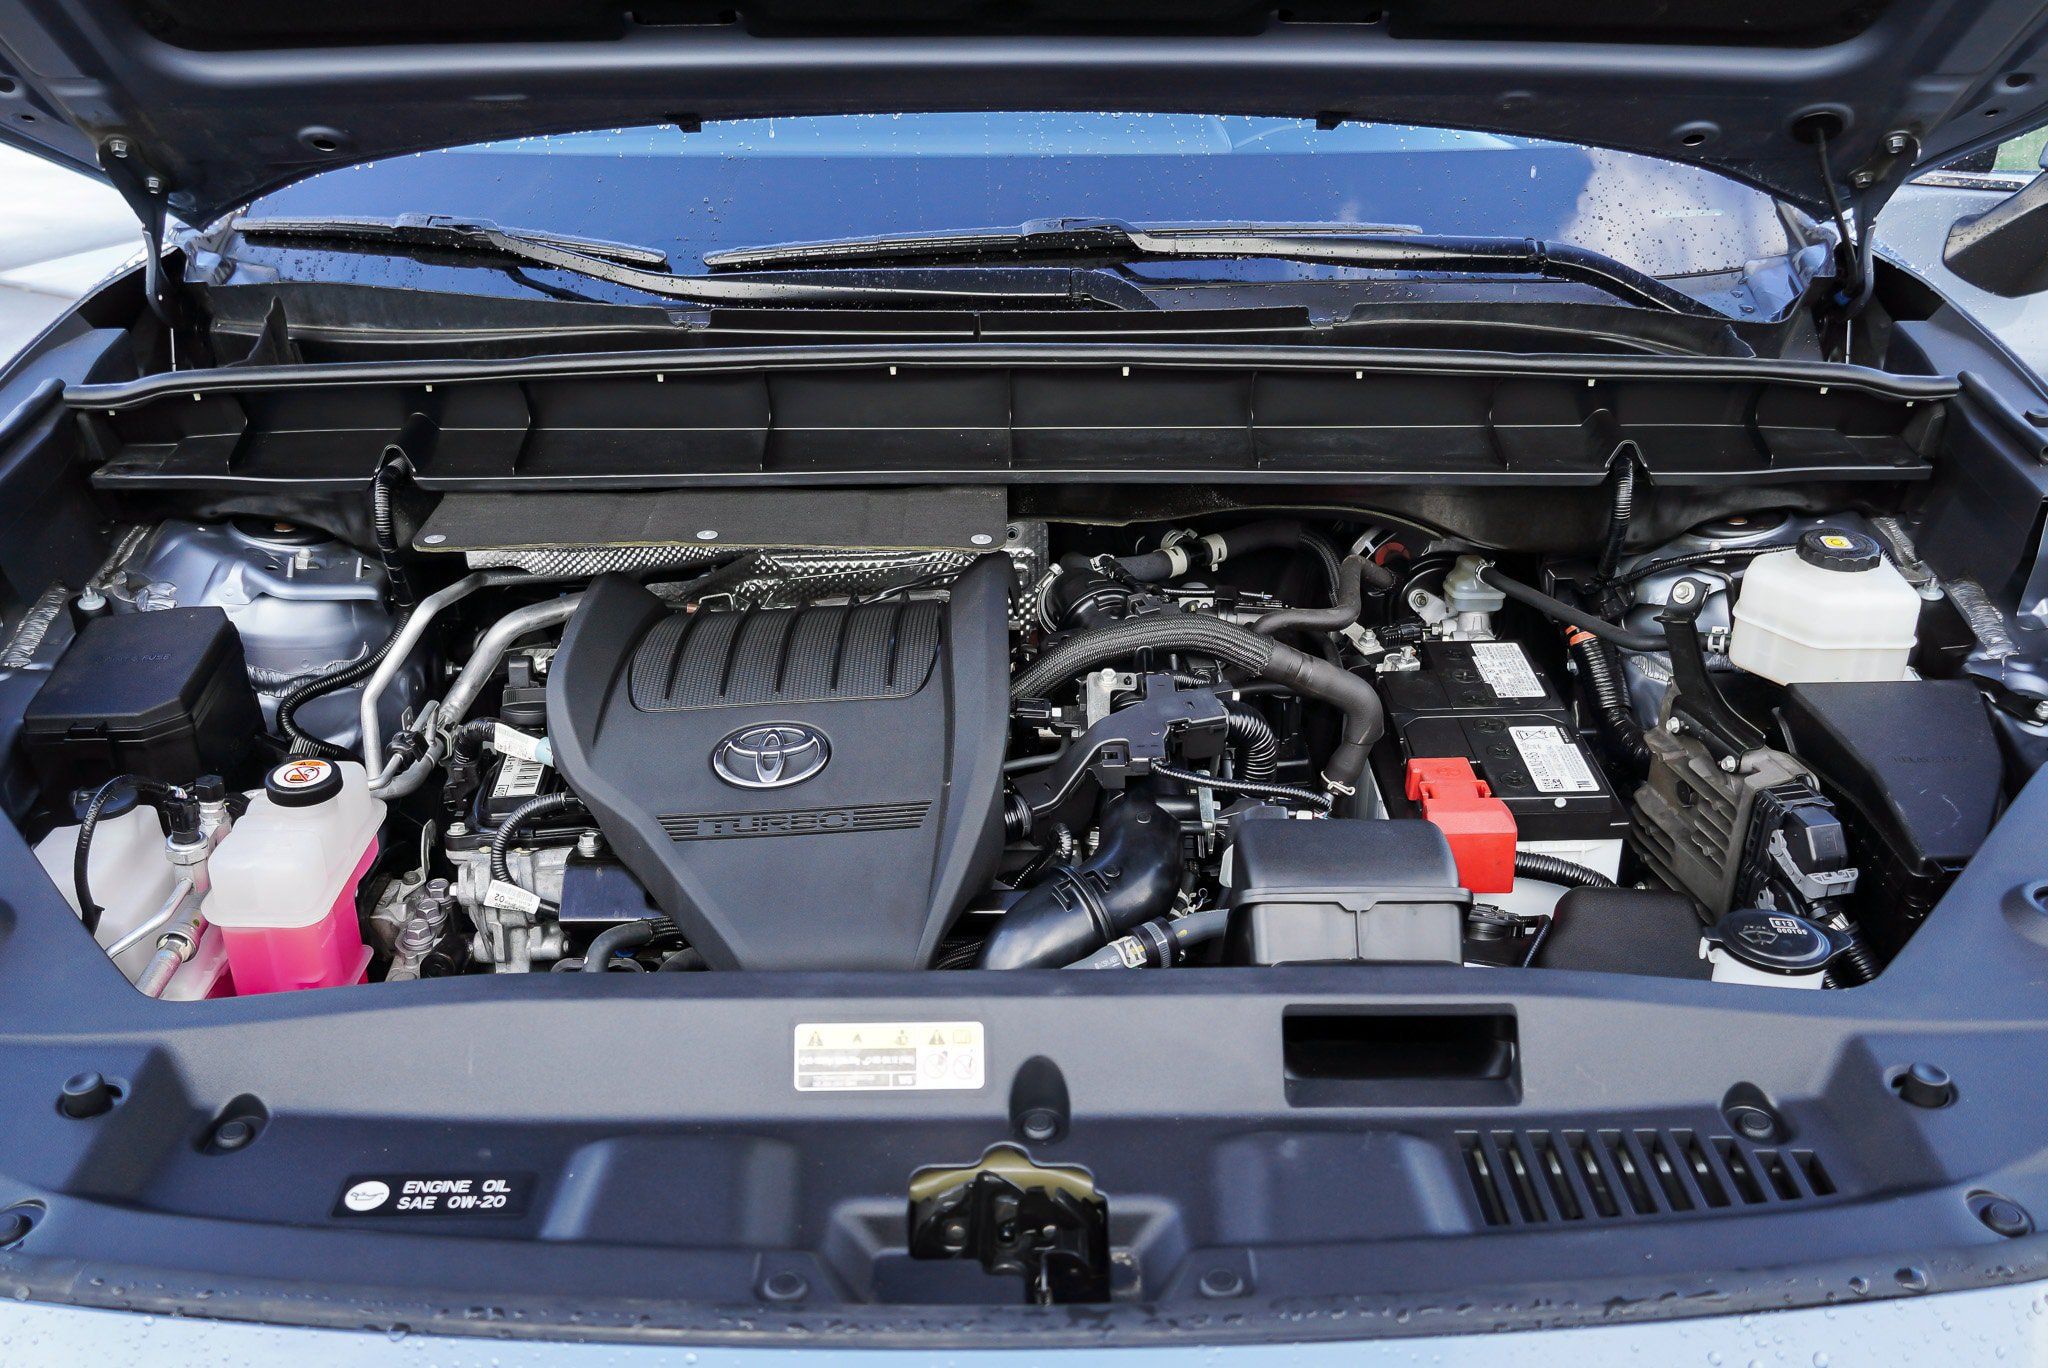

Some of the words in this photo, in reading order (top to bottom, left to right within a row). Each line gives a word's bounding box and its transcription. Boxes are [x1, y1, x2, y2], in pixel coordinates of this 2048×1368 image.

[703, 811, 850, 834] TURBO
[402, 1180, 472, 1195] ENGINE
[482, 1179, 511, 1193] OIL
[396, 1196, 437, 1210] SAE
[447, 1195, 507, 1209] 0W-20
